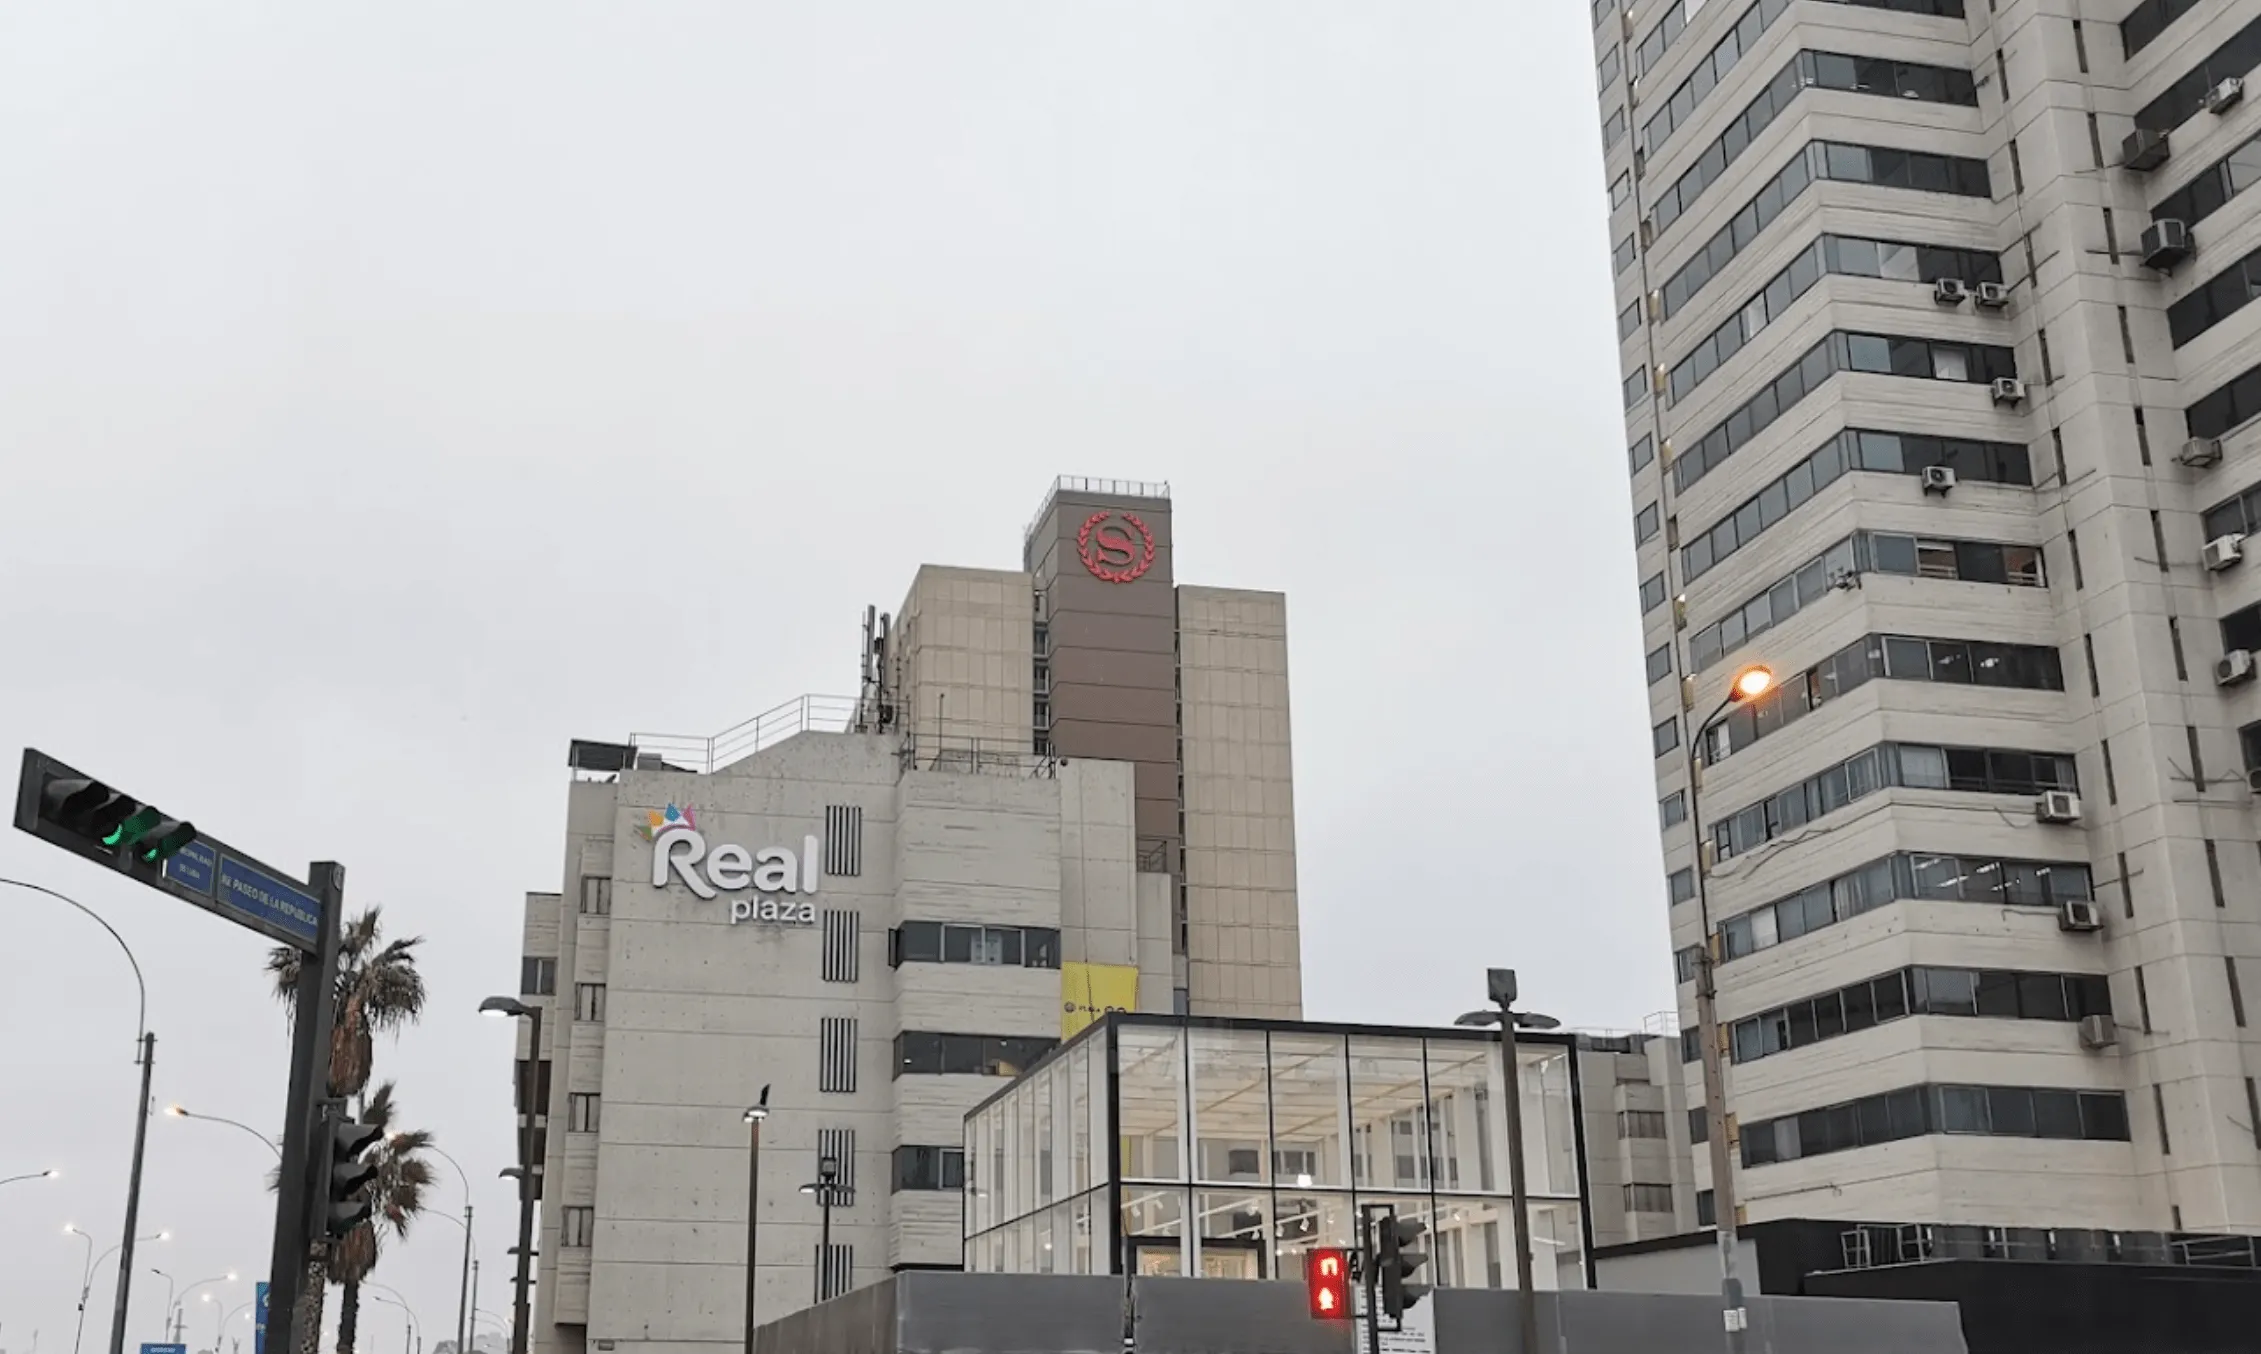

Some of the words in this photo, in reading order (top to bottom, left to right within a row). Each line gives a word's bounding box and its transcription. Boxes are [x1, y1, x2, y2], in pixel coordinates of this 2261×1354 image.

[1095, 525, 1136, 567] S
[652, 828, 820, 900] Real
[234, 880, 258, 900] PASEO
[730, 895, 816, 925] plaza
